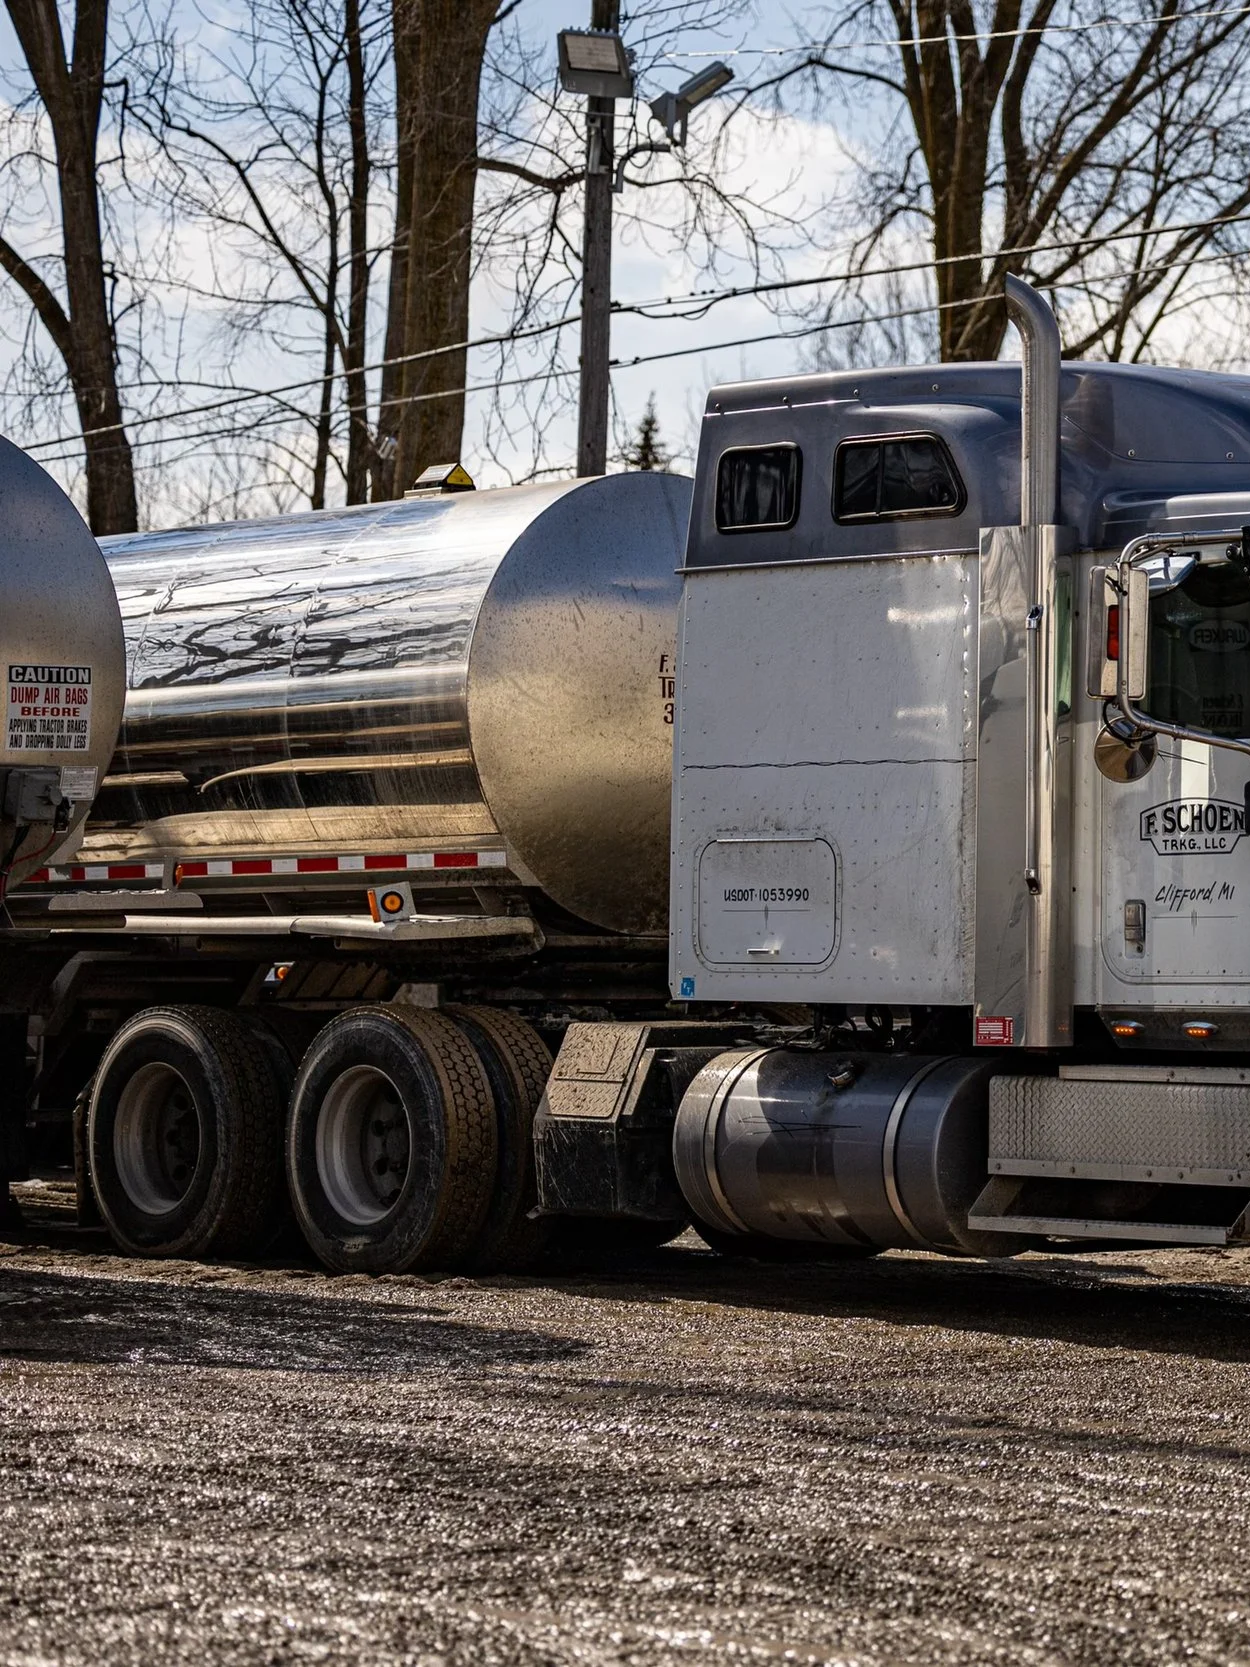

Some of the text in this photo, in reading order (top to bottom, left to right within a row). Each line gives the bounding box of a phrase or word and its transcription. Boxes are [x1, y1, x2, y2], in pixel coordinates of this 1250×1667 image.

[659, 654, 669, 673] F.
[11, 666, 90, 683] CAUTION
[11, 686, 88, 705] DUMP AIR BAGS
[21, 706, 80, 717] BEFORE
[9, 718, 87, 734] APPLYING TRACTOR BRAKES
[9, 734, 86, 749] AND DROPPING DOLLY LEGS
[1163, 803, 1245, 834] SCHOEN
[1204, 838, 1227, 849] LLC
[1217, 881, 1235, 900] MI
